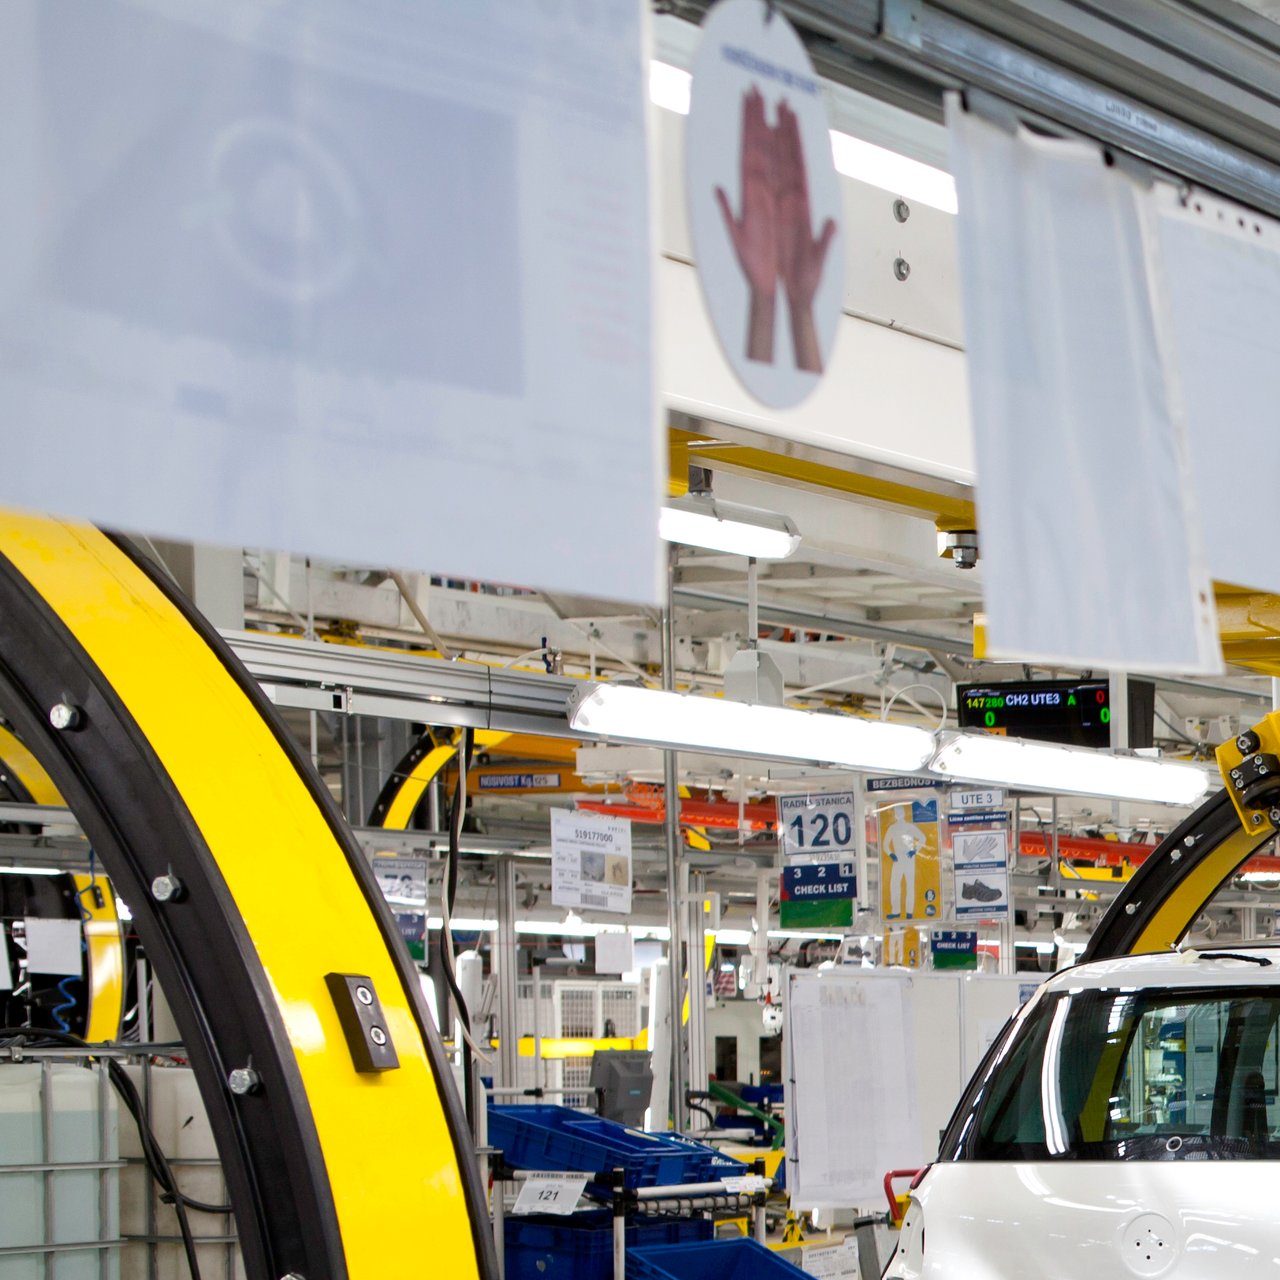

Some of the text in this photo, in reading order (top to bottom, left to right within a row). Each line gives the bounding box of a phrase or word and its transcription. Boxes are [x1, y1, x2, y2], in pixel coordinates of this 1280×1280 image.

[966, 697, 985, 709] 147
[1005, 694, 1029, 706] CH2
[1031, 693, 1060, 705] UTE3
[1067, 697, 1077, 706] A
[985, 711, 995, 727] 0
[873, 779, 936, 789] BEZBEDNOST
[783, 796, 852, 808] RADNA STANICA
[961, 793, 993, 805] UTE 3
[790, 812, 852, 848] 120
[794, 865, 851, 878] 3 2 1
[794, 883, 849, 895] CHECK LIST
[538, 1190, 560, 1201] 121
